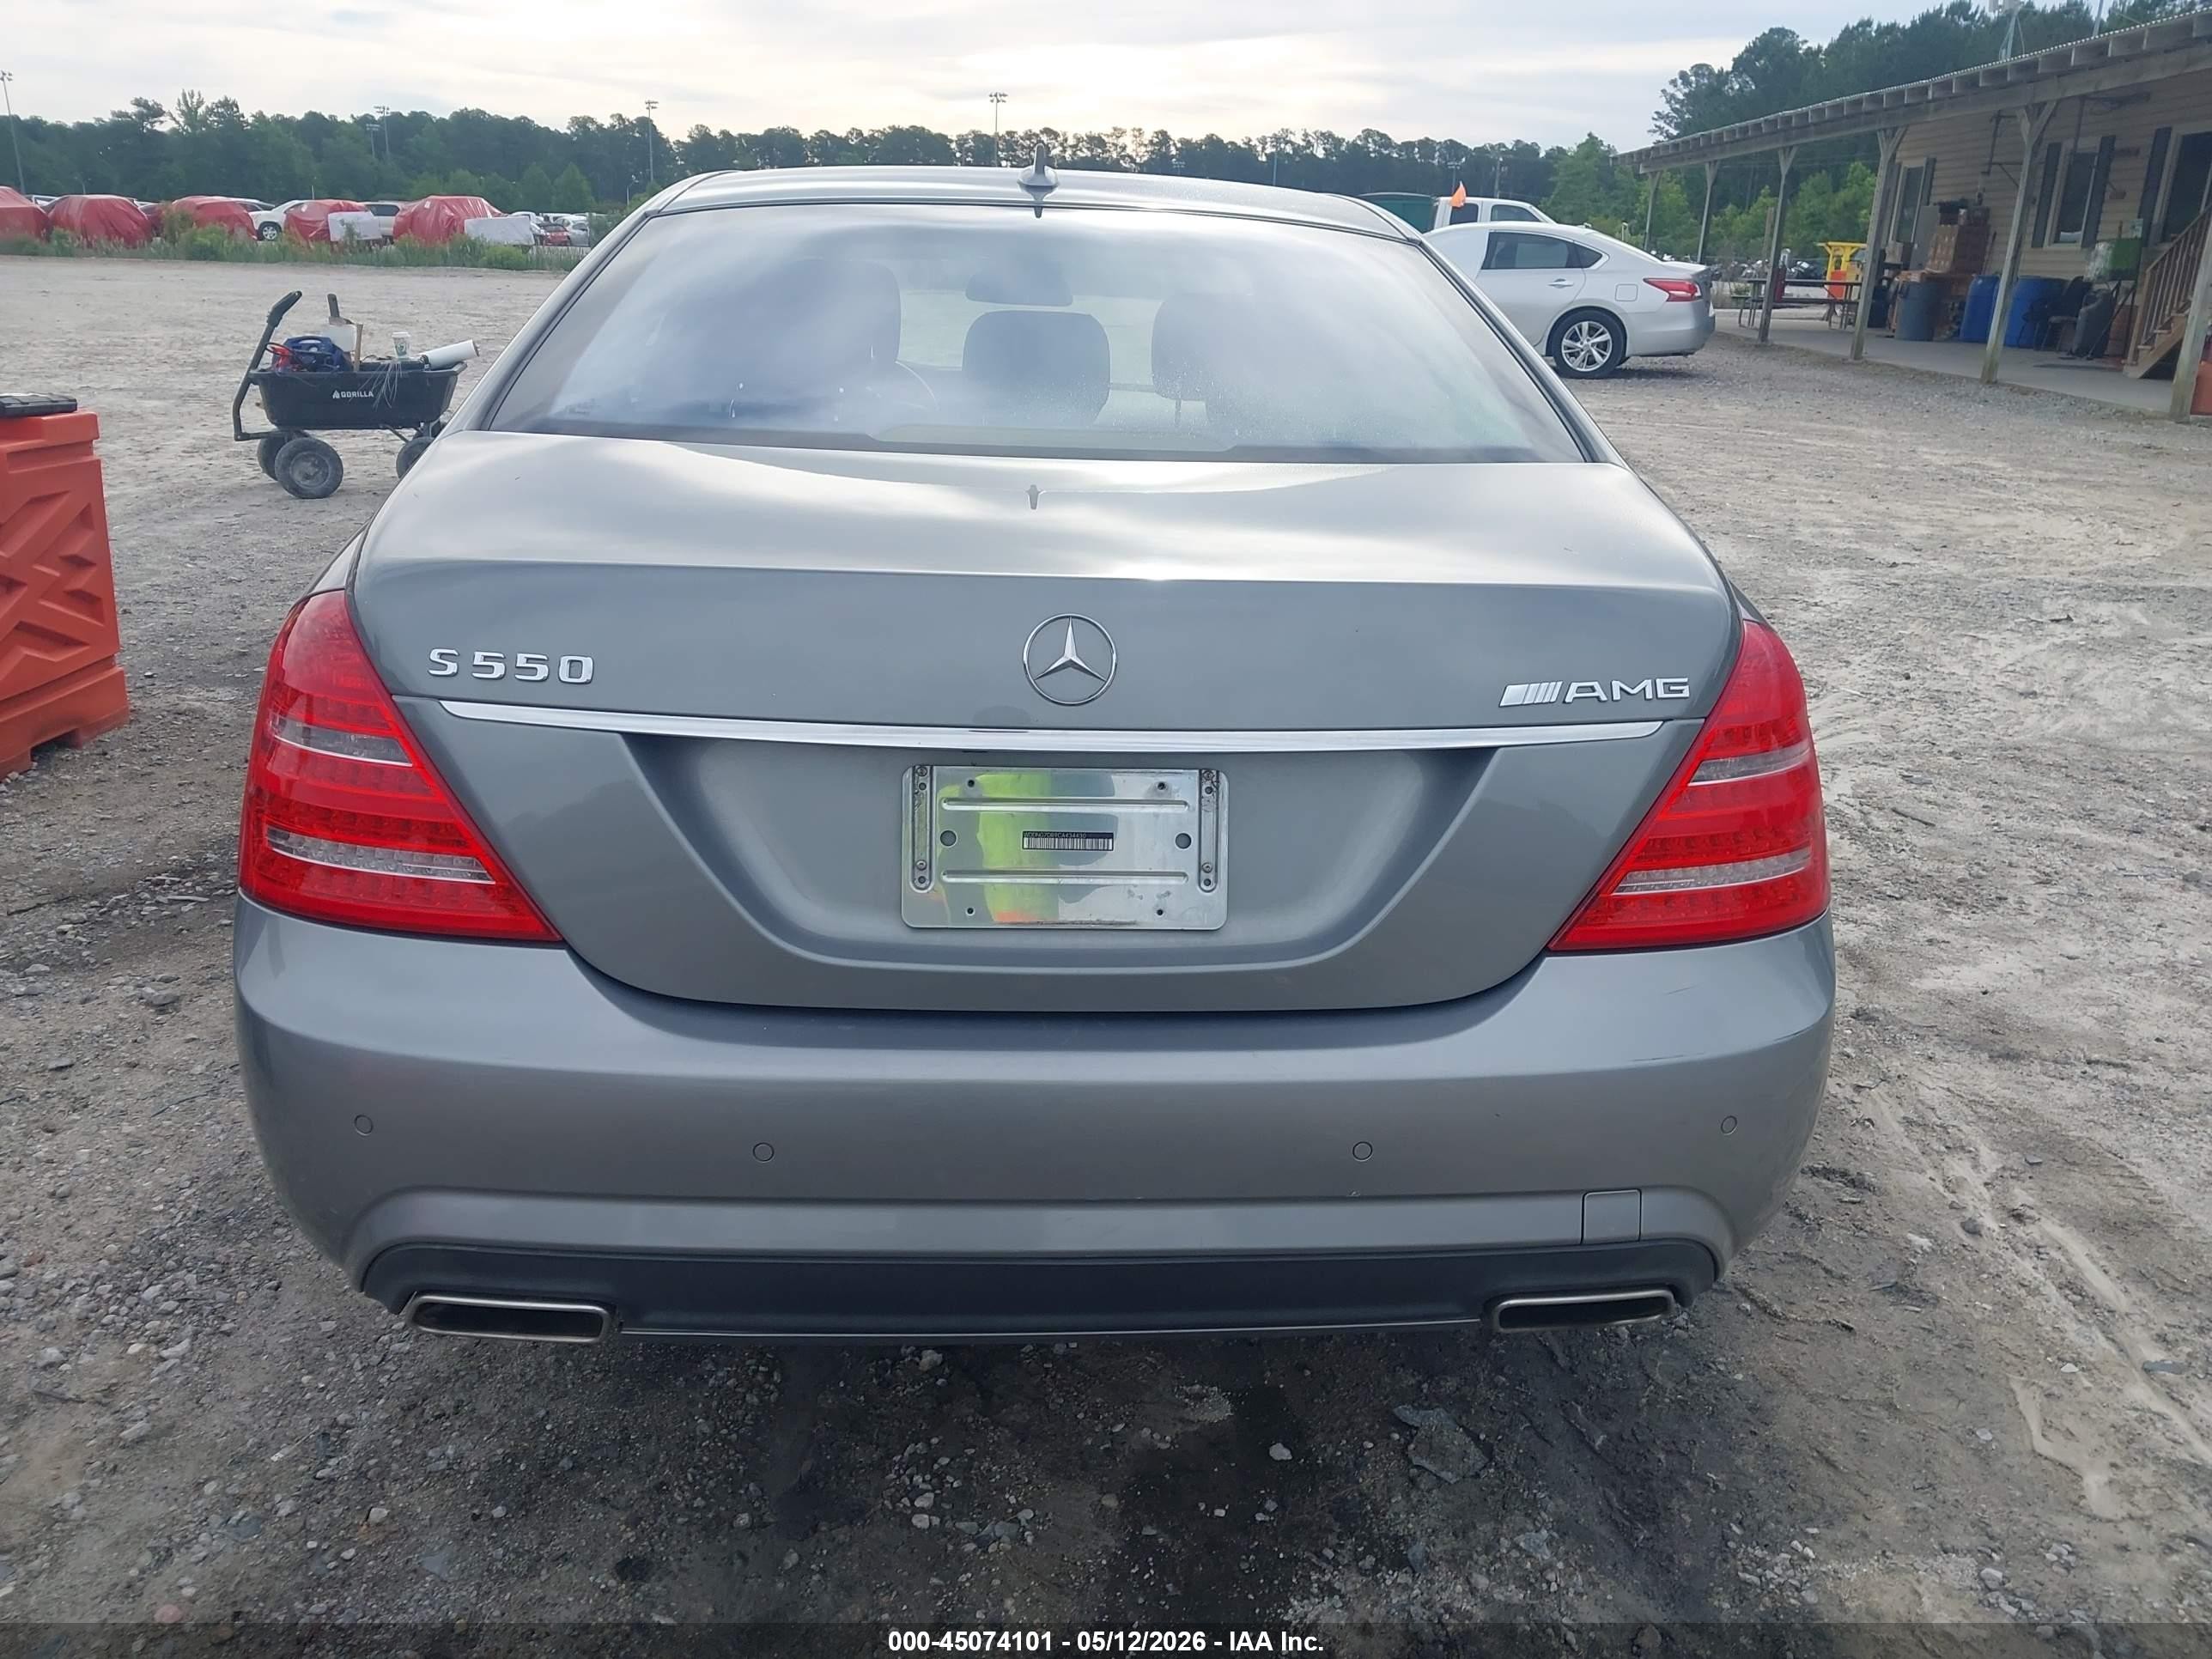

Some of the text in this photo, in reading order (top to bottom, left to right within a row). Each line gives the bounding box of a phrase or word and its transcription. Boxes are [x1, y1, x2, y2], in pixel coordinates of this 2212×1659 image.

[428, 648, 594, 684] S 550
[1564, 678, 1690, 704] AMG
